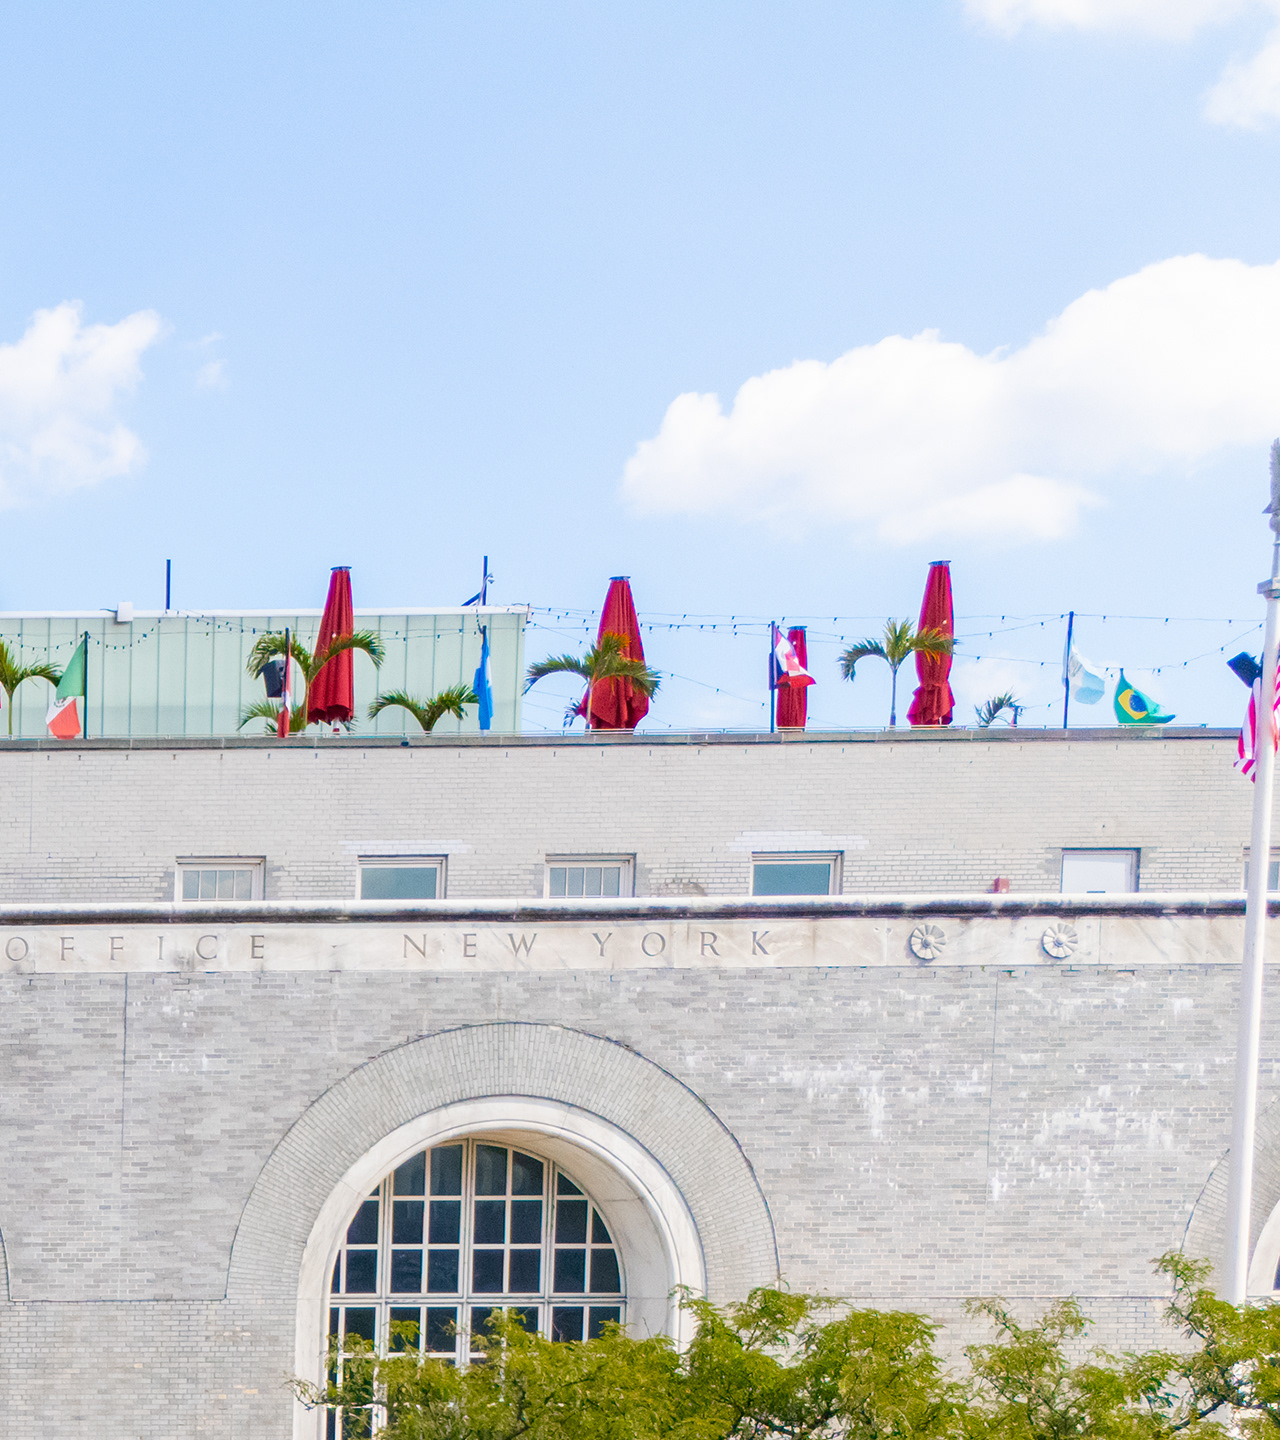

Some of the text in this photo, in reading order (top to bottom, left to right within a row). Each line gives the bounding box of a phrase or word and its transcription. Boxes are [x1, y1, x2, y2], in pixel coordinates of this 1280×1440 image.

[4, 935, 266, 964] OFFICE
[402, 932, 538, 960] NEW
[591, 930, 772, 958] YORK
